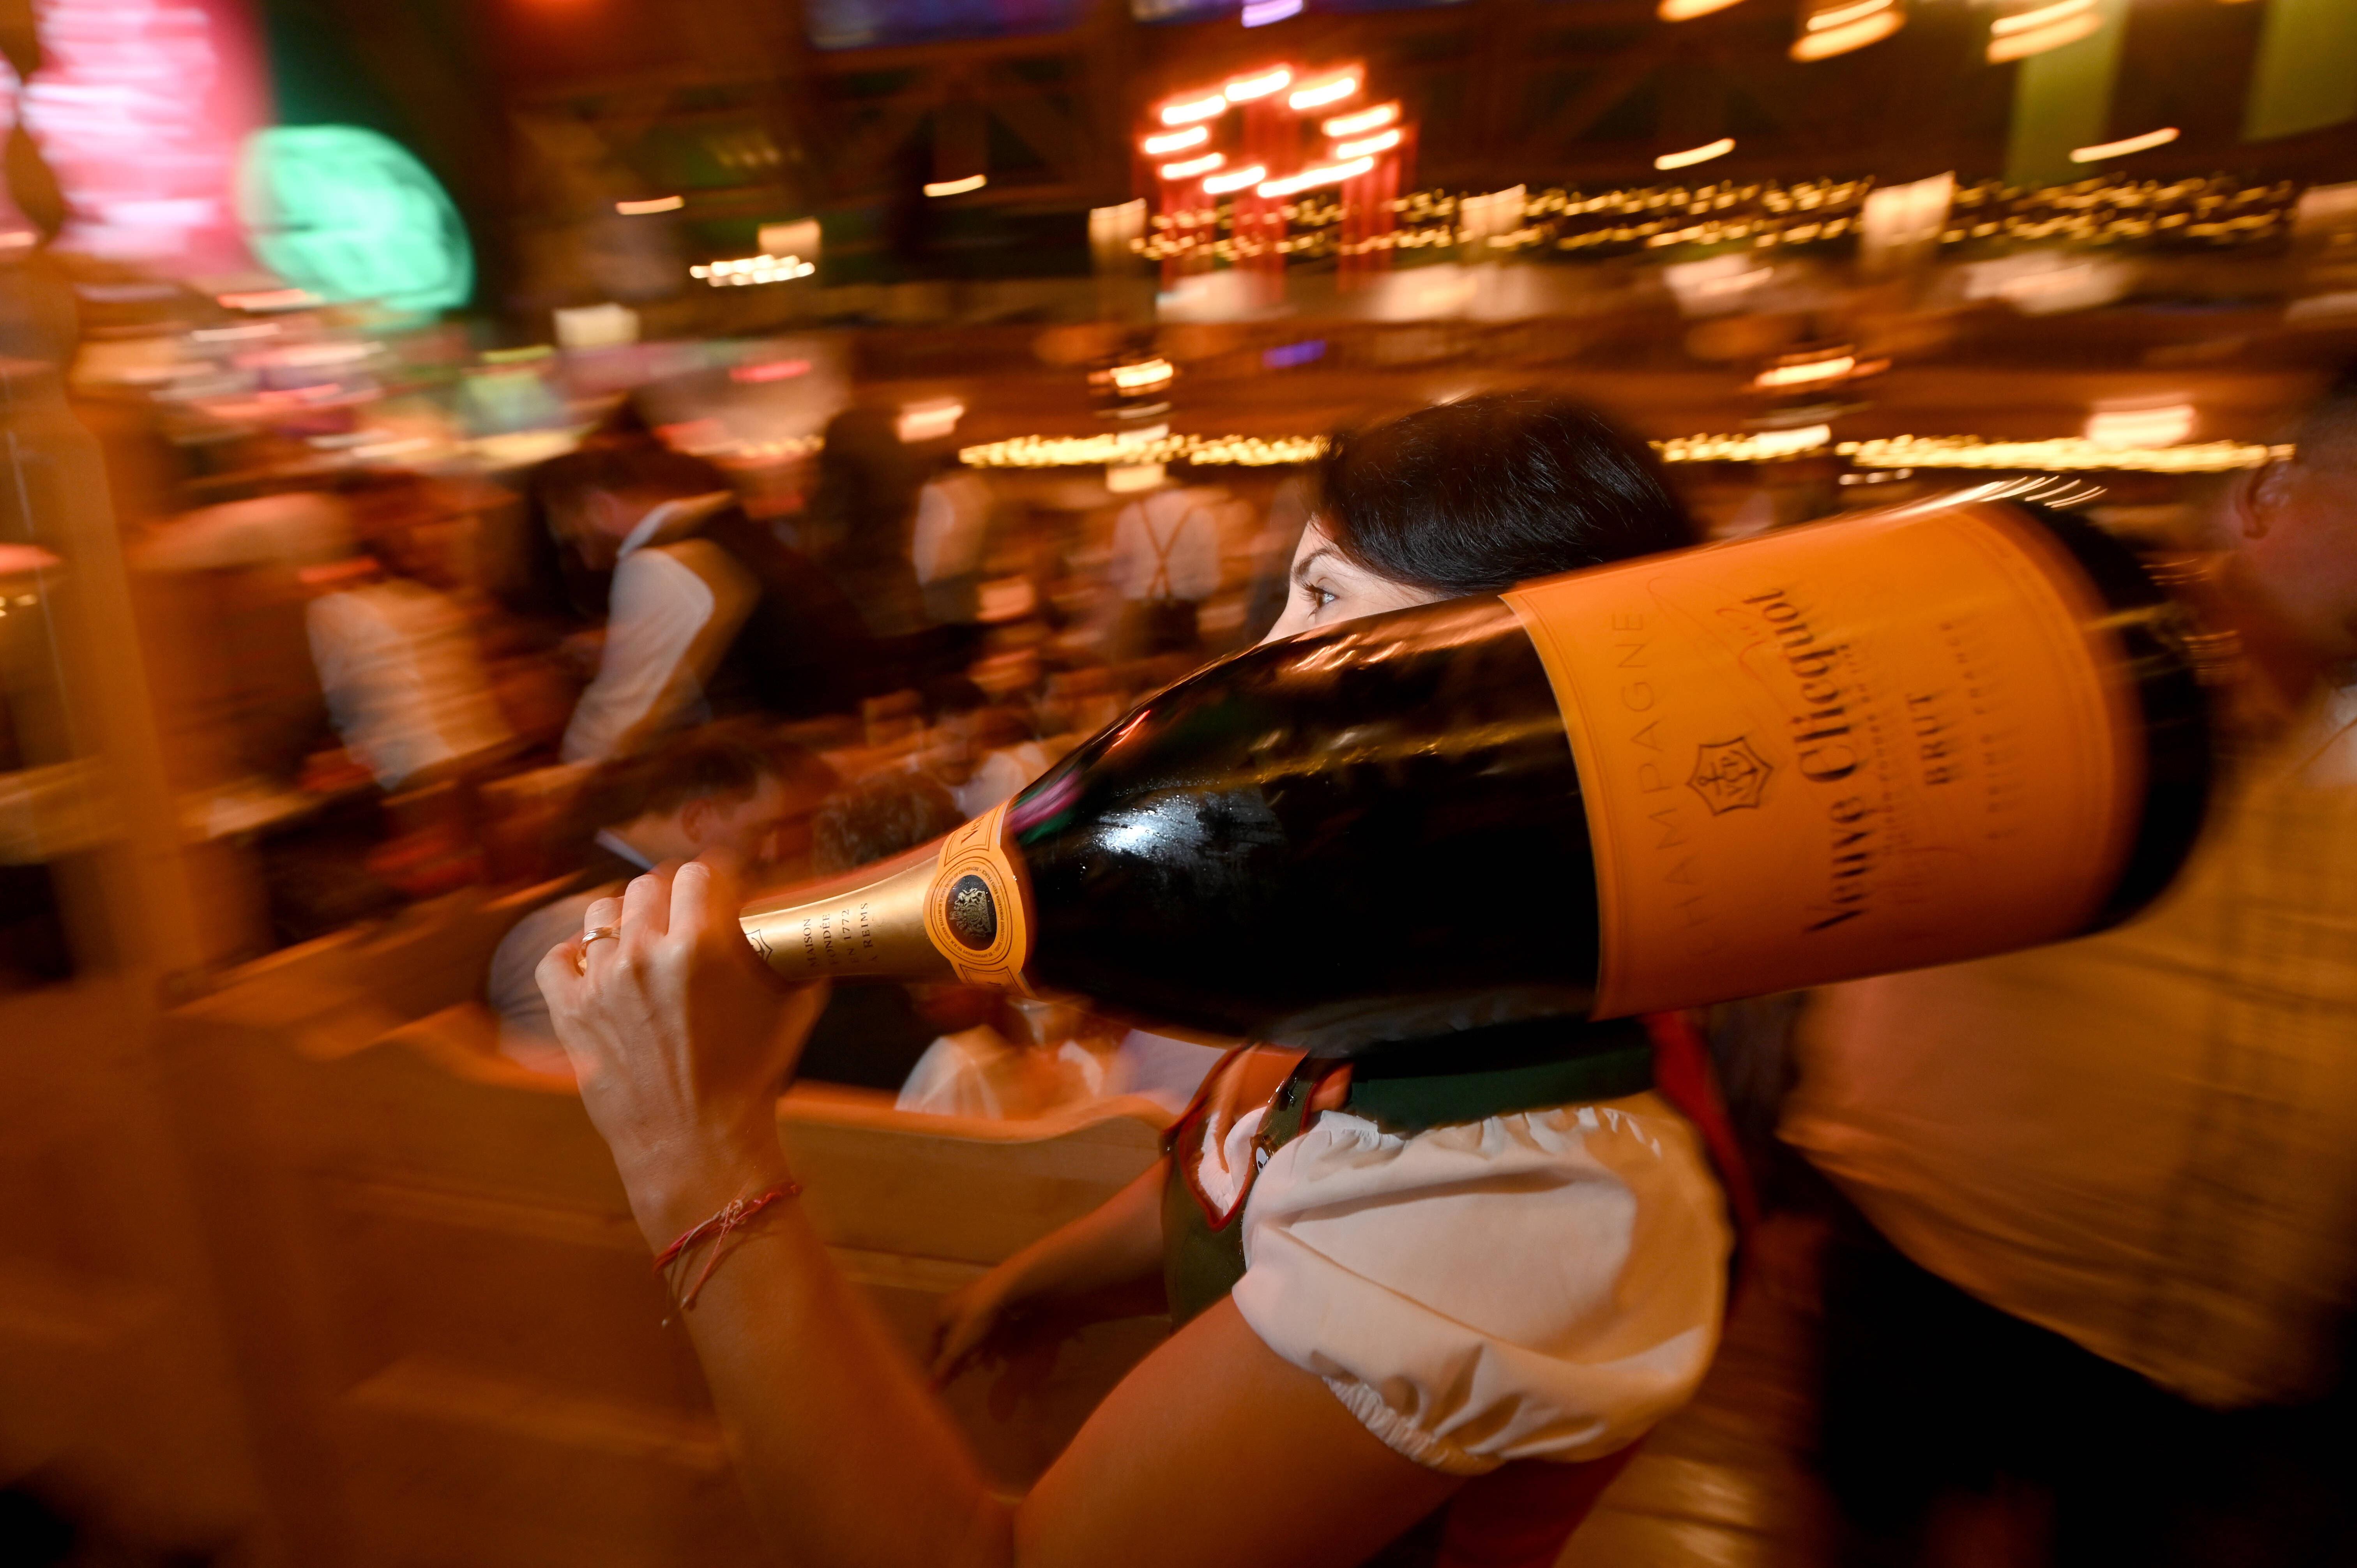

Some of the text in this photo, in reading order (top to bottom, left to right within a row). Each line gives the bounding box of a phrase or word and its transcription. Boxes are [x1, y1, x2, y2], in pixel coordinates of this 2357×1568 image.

[1741, 587, 1868, 934] Veuve Clicquot
[1904, 692, 1950, 785] BRUT
[1611, 611, 1719, 957] CHAMPAGNE
[803, 918, 817, 966] MAISON
[820, 913, 837, 964] FONDÉE
[841, 909, 859, 963] EN 1772
[860, 902, 873, 948] REIMS
[942, 926, 951, 939] QUEEN
